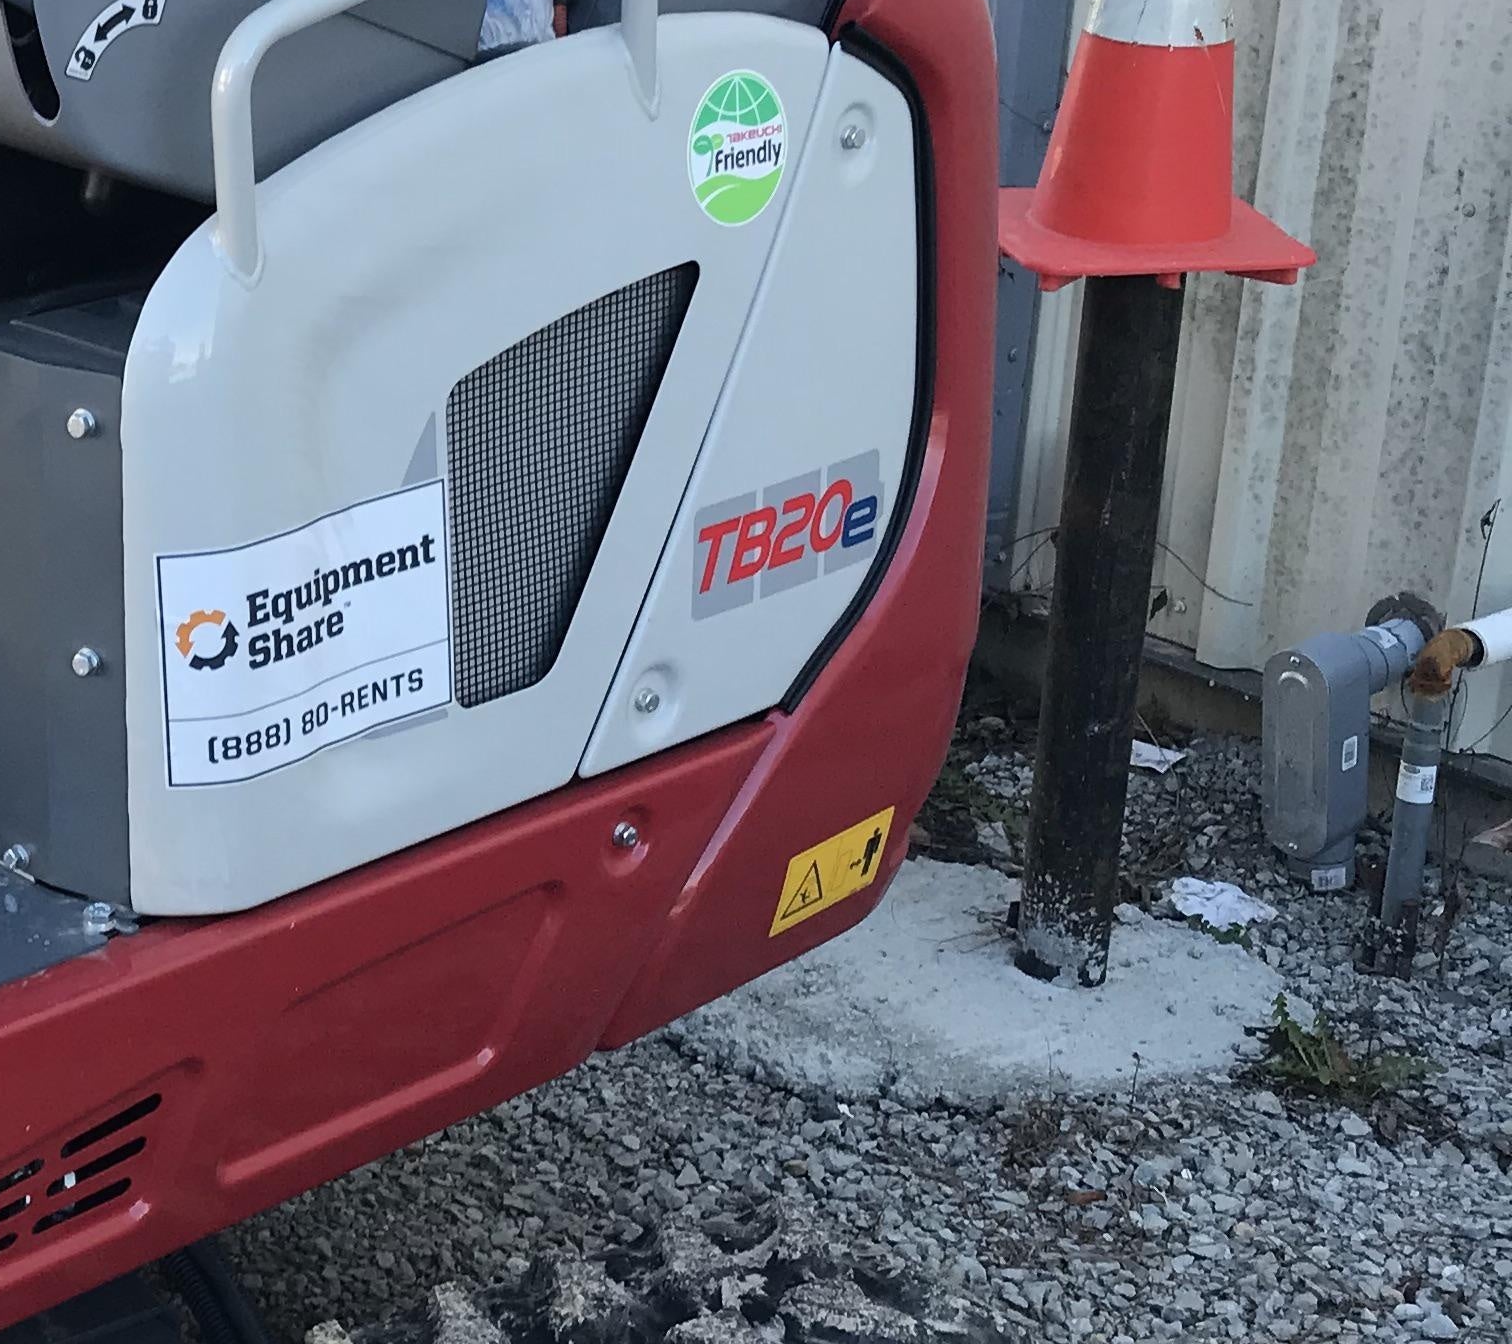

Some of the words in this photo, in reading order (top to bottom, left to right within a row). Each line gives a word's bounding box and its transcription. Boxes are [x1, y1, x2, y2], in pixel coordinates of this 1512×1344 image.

[715, 138, 782, 173] Friendly
[726, 123, 783, 145] TAKEUCHI
[698, 478, 878, 595] TB20e
[246, 533, 436, 628] Equipment
[248, 609, 345, 670] Share
[208, 717, 291, 764] (888)
[301, 668, 424, 736] 80-RENTS
